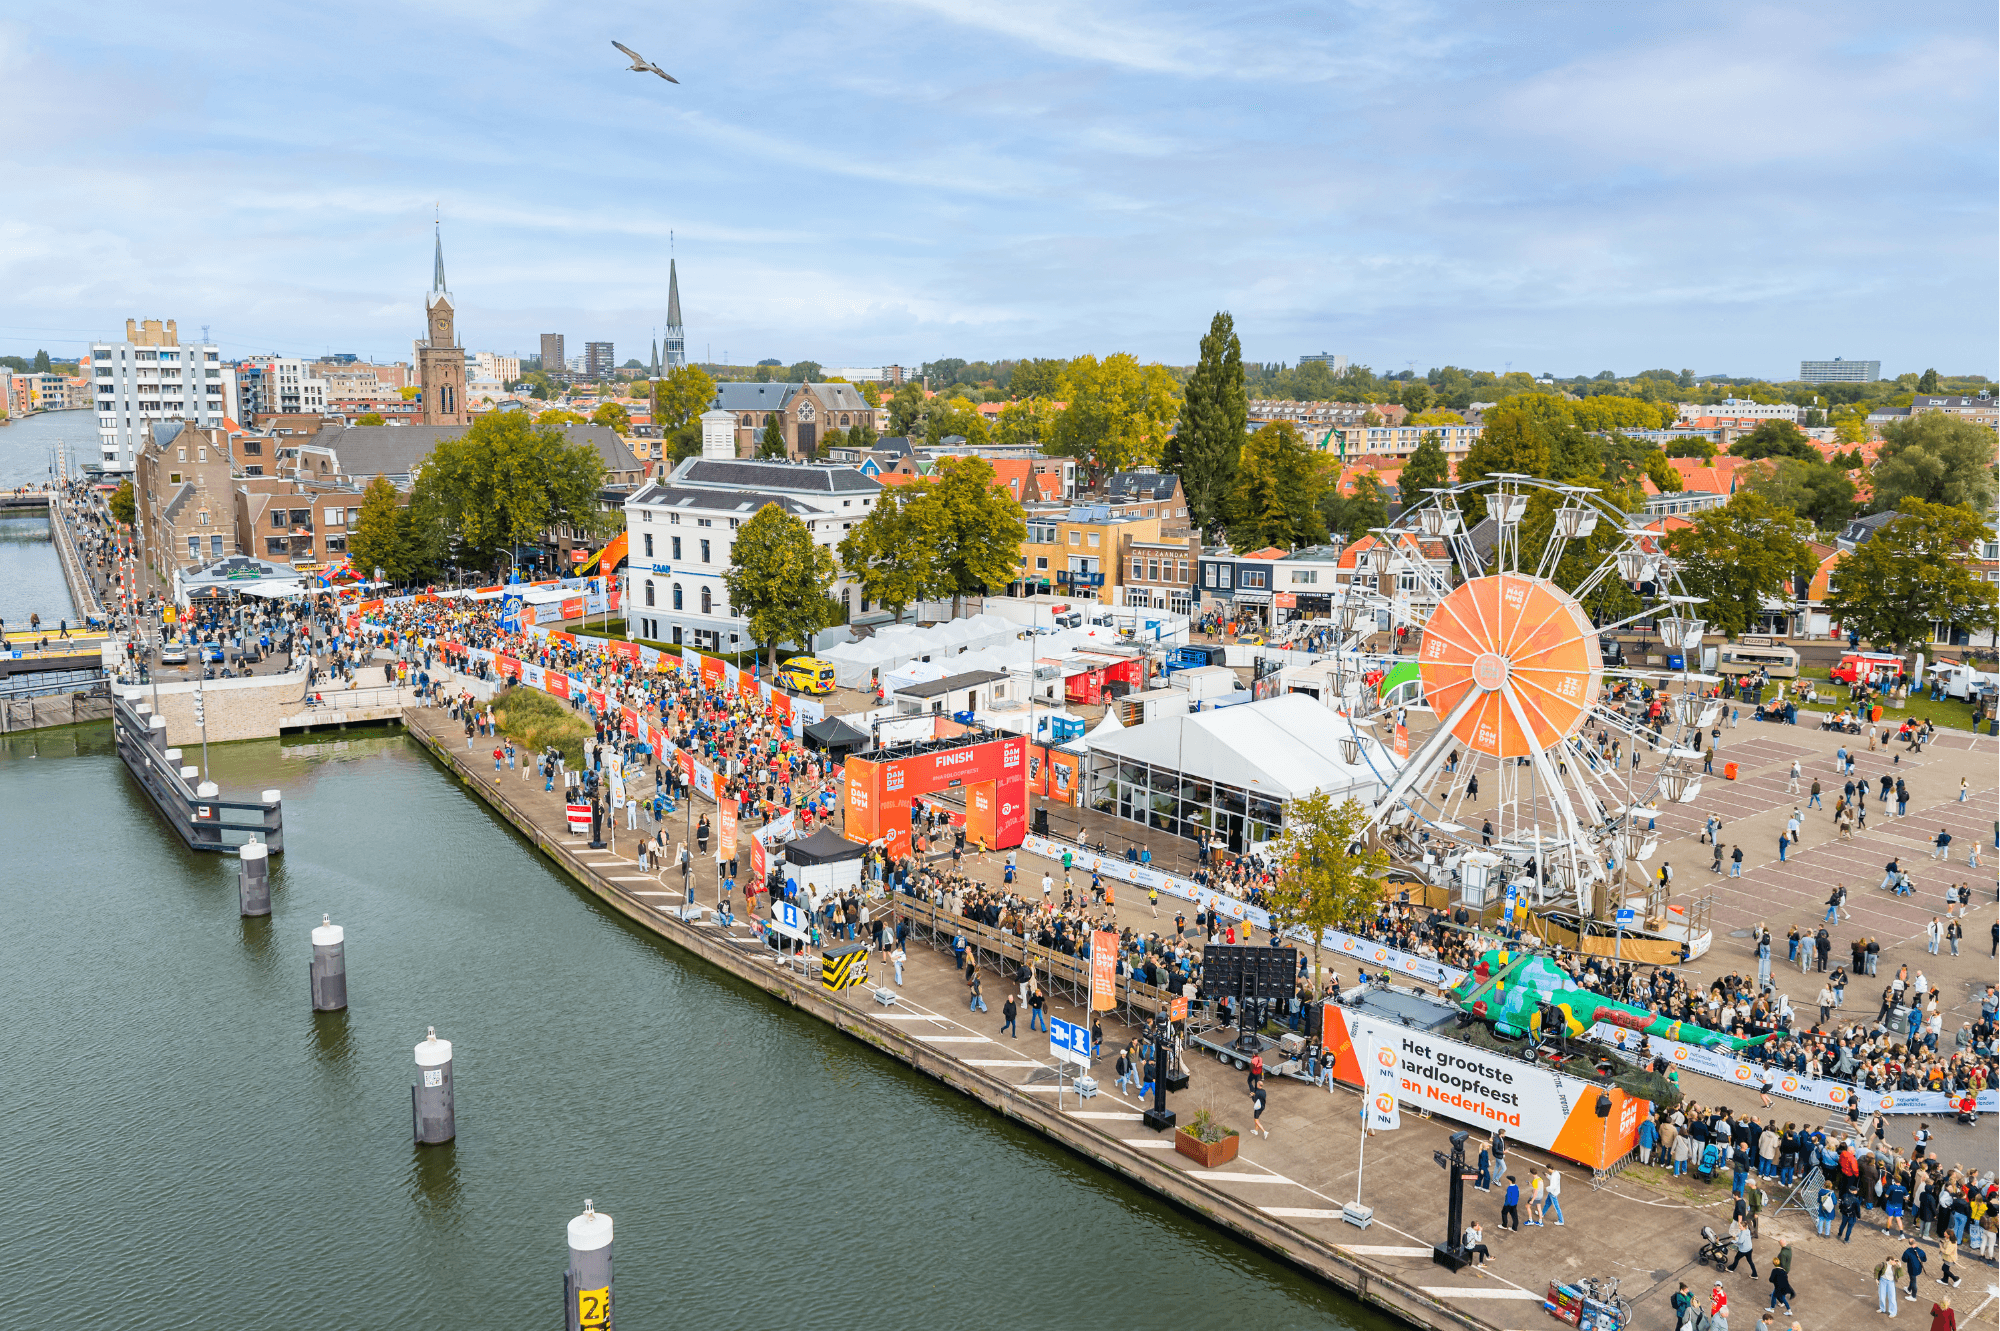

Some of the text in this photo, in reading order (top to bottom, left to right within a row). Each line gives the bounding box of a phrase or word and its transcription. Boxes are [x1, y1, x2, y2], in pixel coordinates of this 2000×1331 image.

[1745, 638, 1770, 646] PIZZERIA
[1004, 748, 1020, 756] DAM
[936, 750, 974, 768] FINISH
[886, 770, 904, 780] DAM
[850, 788, 868, 800] DAM
[1096, 952, 1114, 962] DAM
[1402, 1038, 1514, 1084] Het grootste
[1380, 1069, 1394, 1078] NN
[1800, 1084, 1812, 1092] NN
[1426, 1085, 1520, 1127] Nederland
[1620, 1102, 1638, 1122] DAM
[1378, 1115, 1391, 1124] NN
[583, 1296, 600, 1320] 2
